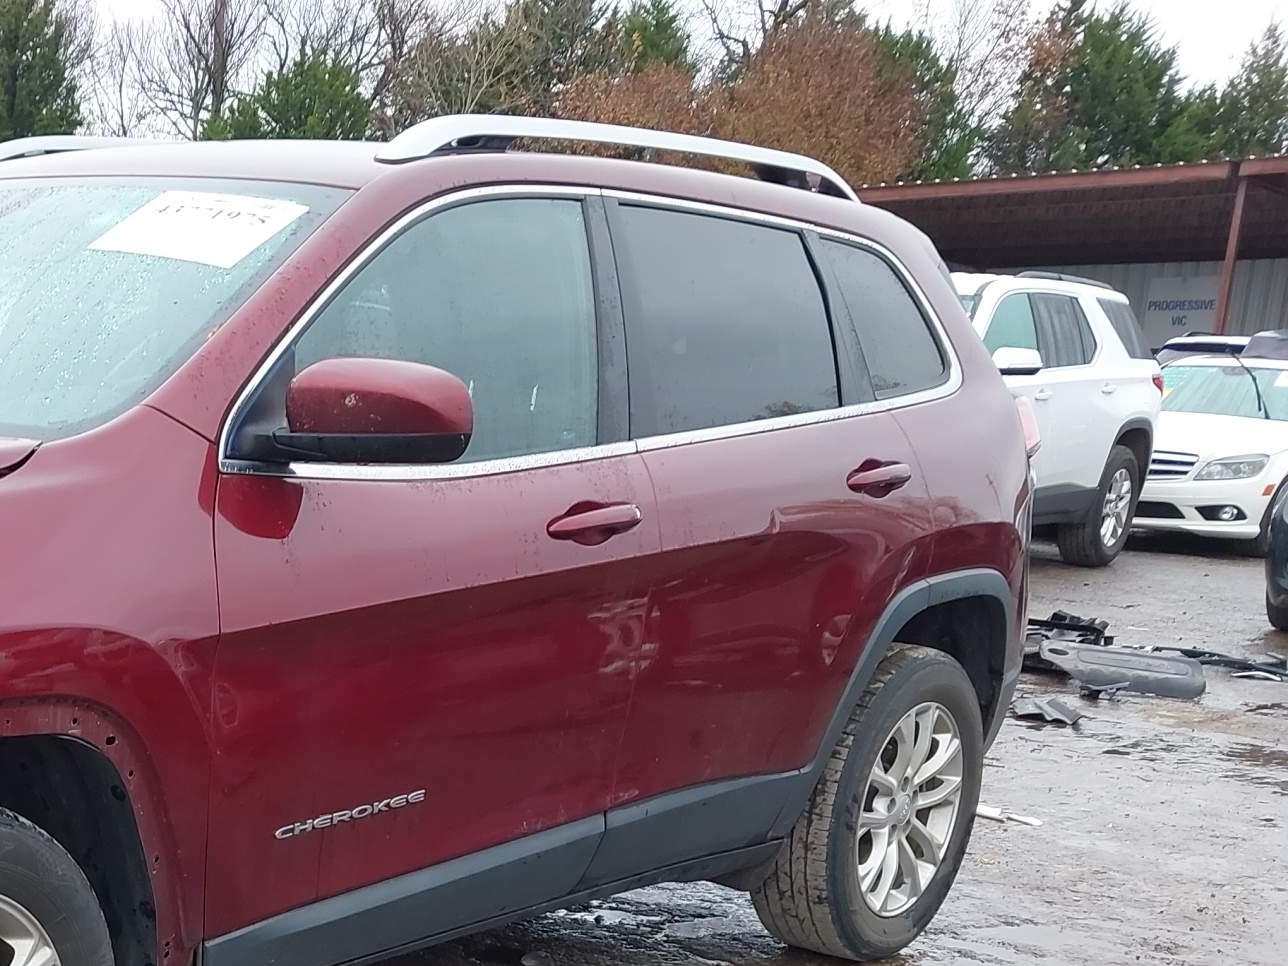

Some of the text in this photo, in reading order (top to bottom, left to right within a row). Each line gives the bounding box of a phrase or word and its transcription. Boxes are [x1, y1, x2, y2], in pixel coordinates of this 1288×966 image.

[1147, 299, 1216, 311] PROGRESSIVE
[1170, 315, 1187, 326] VIC
[274, 789, 426, 839] CHEROKEE
